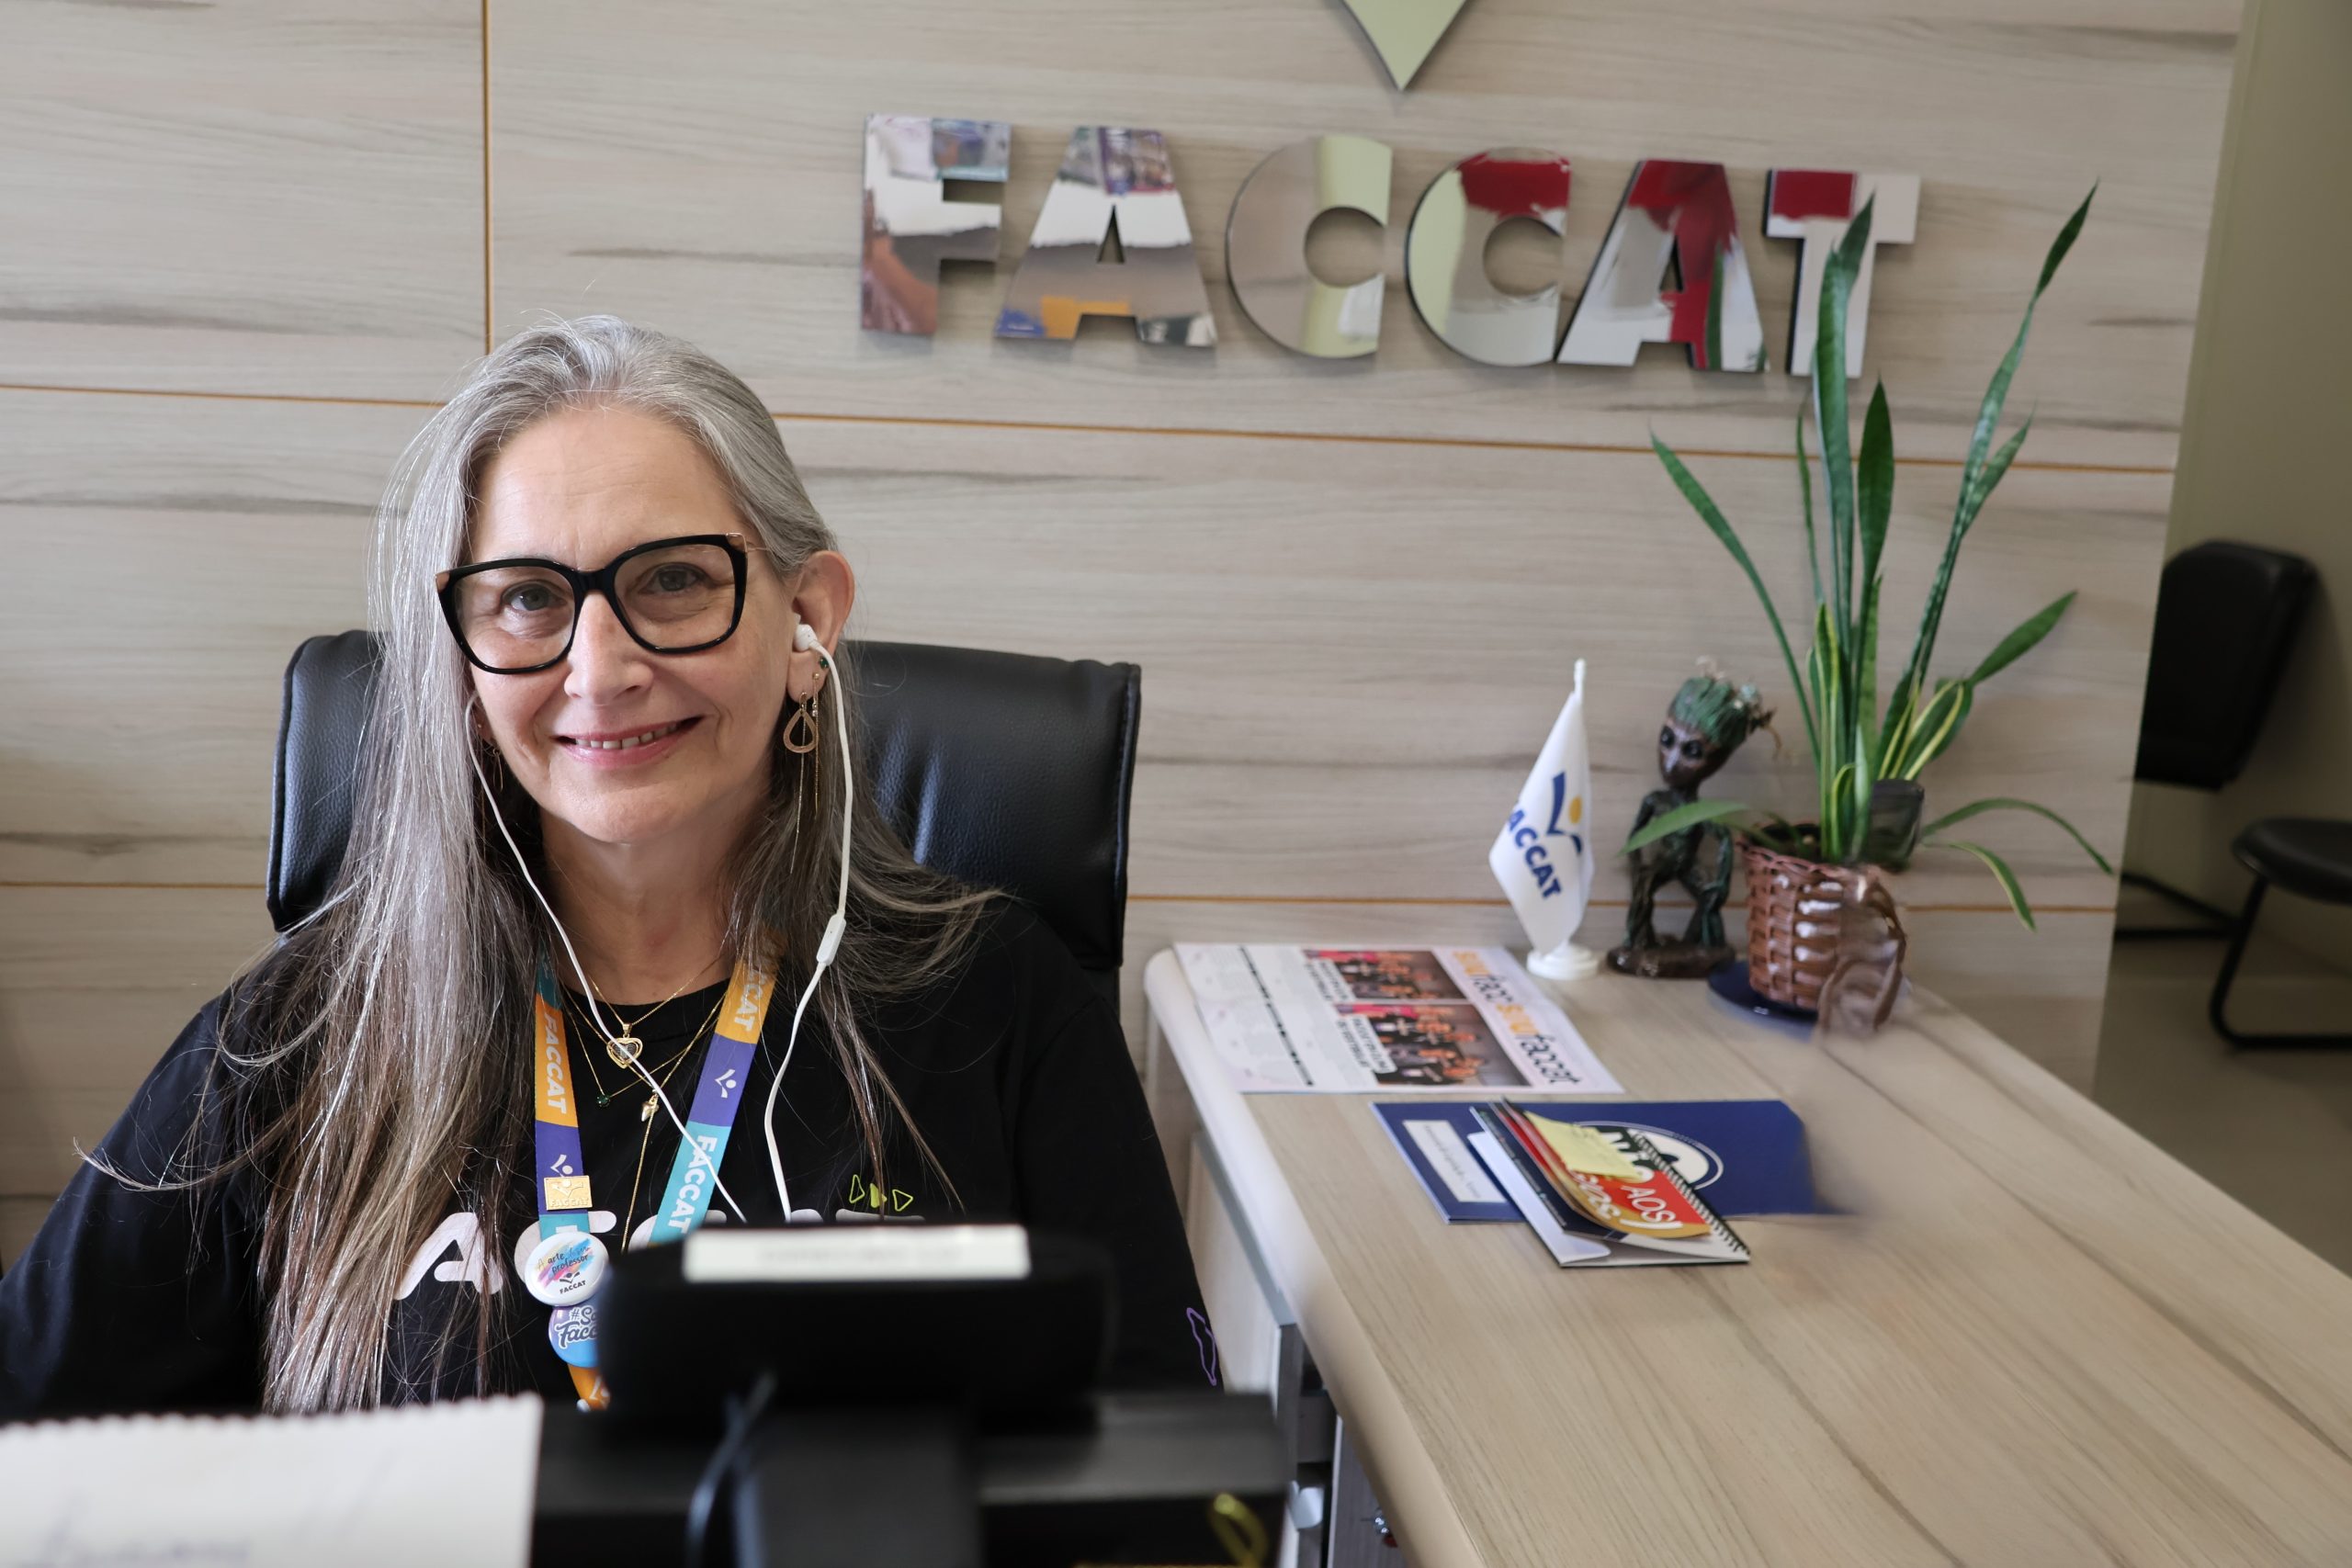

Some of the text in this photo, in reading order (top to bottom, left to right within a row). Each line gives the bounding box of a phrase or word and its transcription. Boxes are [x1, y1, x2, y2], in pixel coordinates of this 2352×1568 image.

[861, 115, 1920, 378] FACCAT
[1509, 809, 1561, 898] ACCAT
[544, 1013, 567, 1114] FACCAT
[668, 1135, 718, 1235] FACCAT
[551, 1254, 589, 1276] professor
[560, 1280, 587, 1294] FACCAT
[556, 1321, 598, 1348] Facc
[571, 1306, 597, 1325] #So
